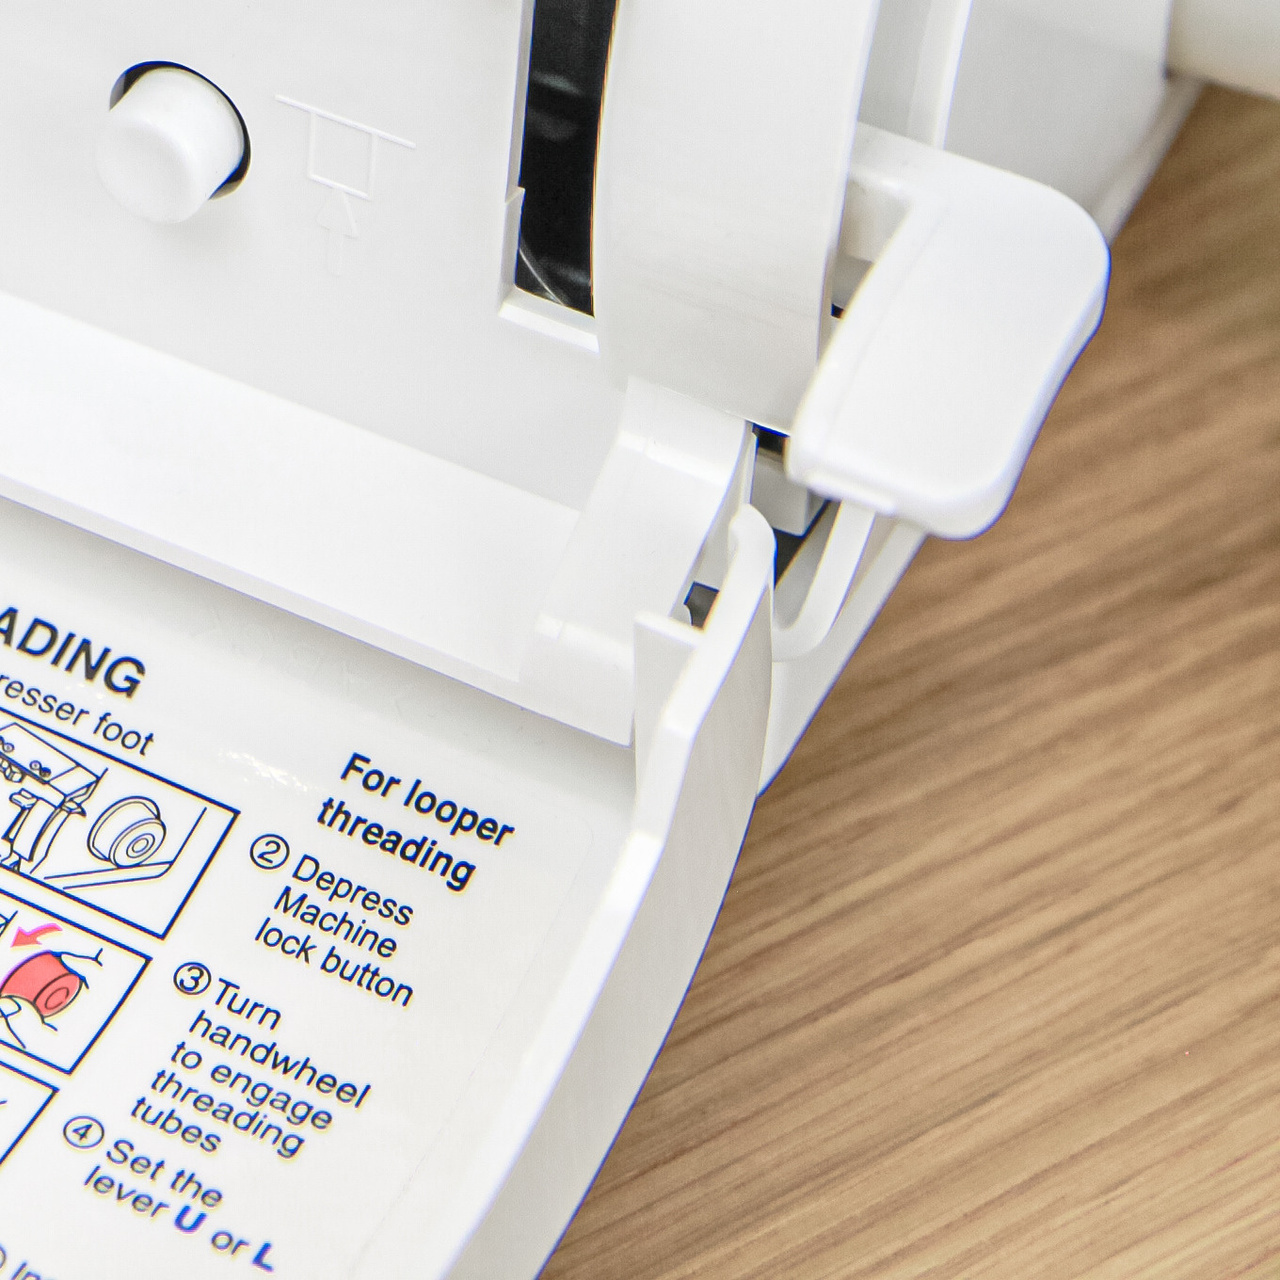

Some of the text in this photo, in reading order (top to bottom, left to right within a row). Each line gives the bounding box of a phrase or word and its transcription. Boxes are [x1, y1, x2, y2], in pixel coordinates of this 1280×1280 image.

[93, 712, 154, 756] foot
[340, 752, 516, 846] For looper
[317, 797, 477, 892] threading
[273, 885, 398, 958] Machine
[292, 853, 414, 926] Depress
[215, 977, 282, 1030] Turn
[254, 916, 414, 1007] lock button
[170, 1041, 333, 1130] to engage
[189, 1009, 372, 1109] handwheel
[131, 1096, 222, 1153] tubes
[151, 1069, 306, 1159] threading
[106, 1139, 166, 1181] Set
[170, 1168, 224, 1208] the
[83, 1165, 275, 1273] lever U or L
